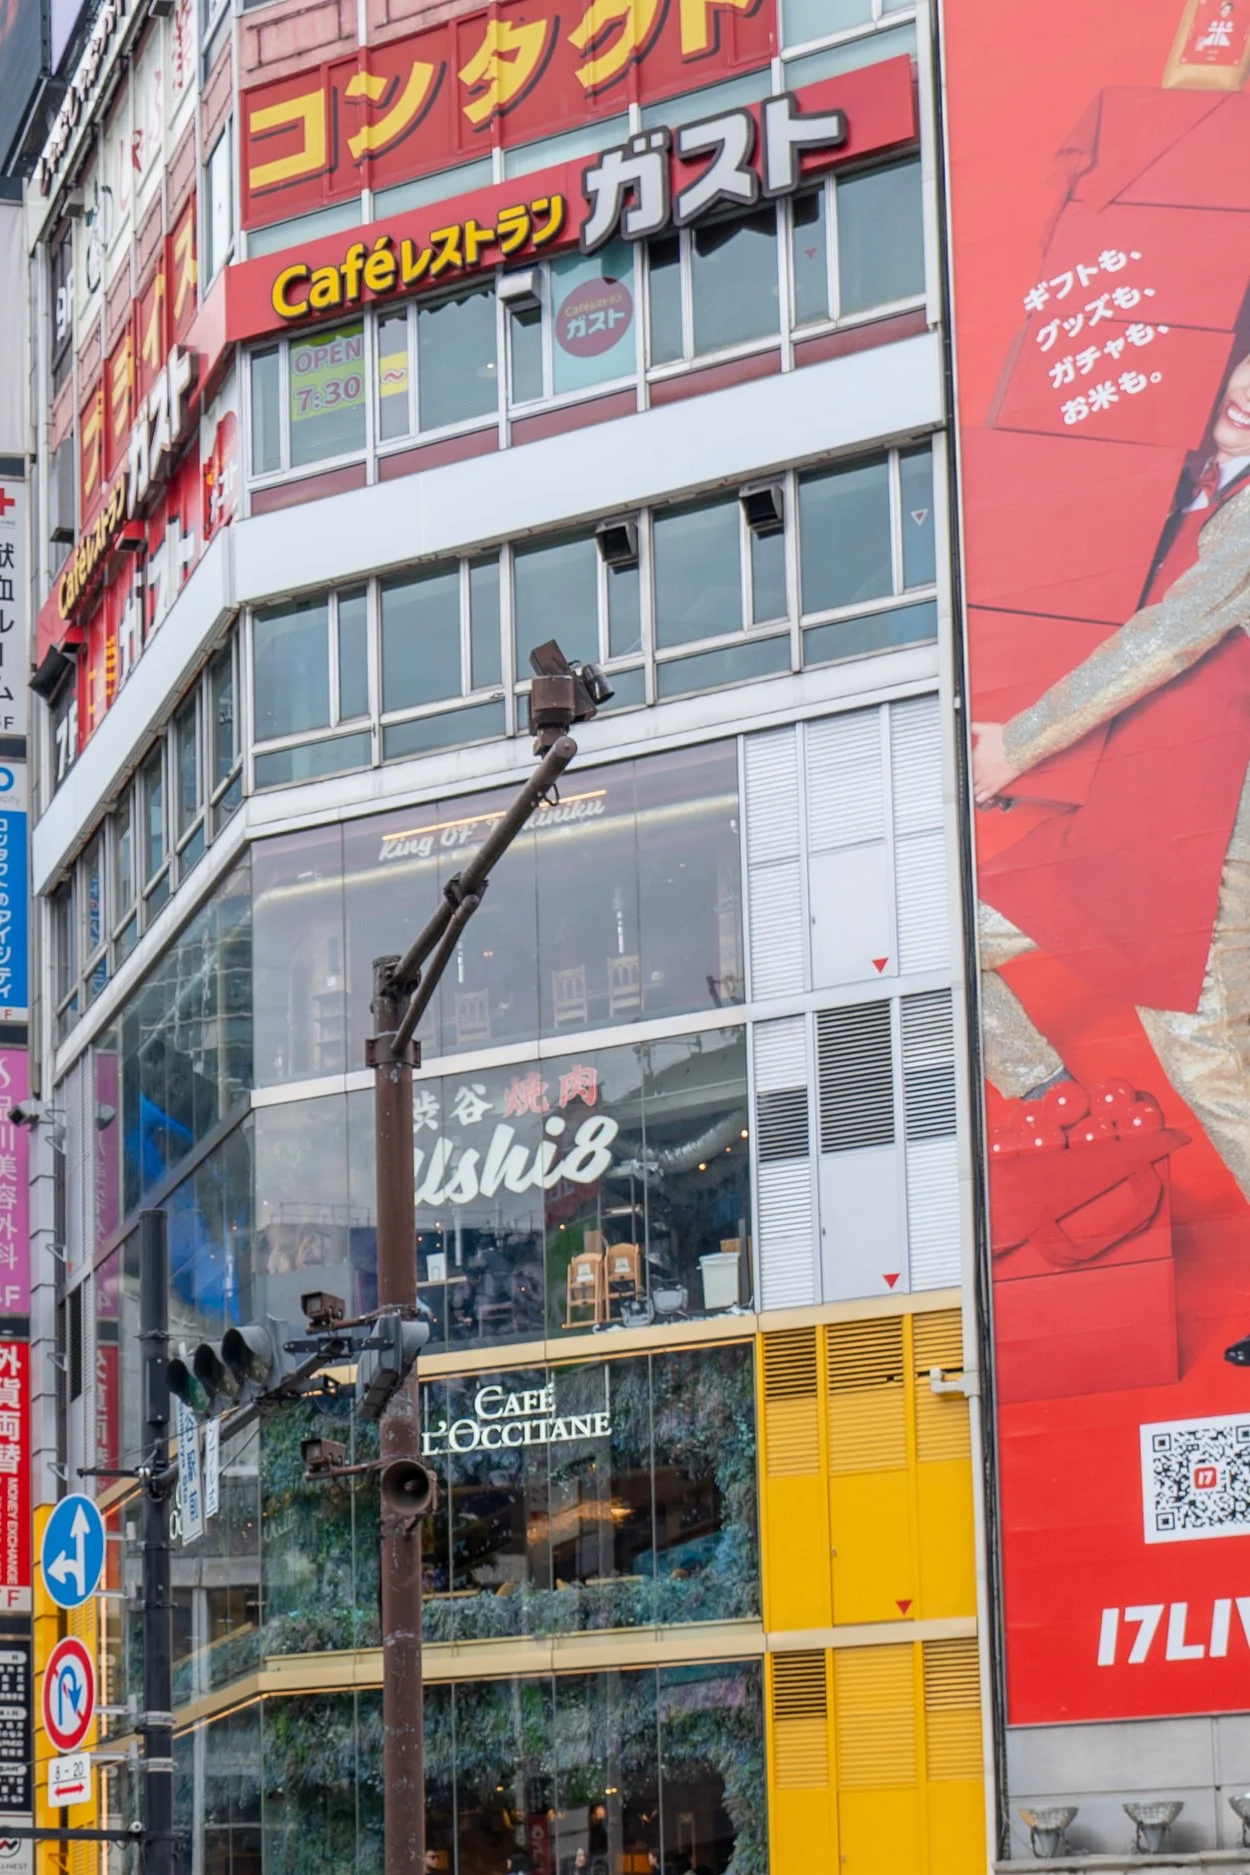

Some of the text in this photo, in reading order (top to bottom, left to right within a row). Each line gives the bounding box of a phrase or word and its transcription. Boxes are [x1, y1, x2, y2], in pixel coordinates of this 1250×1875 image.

[249, 0, 766, 190] コンタクト
[272, 195, 564, 318] Caféレストラン
[581, 92, 845, 254] ガスト
[1023, 247, 1143, 314] ギフトも、
[565, 309, 626, 340] ガスト
[1035, 285, 1156, 352] グッズも、
[294, 338, 362, 376] OPEN
[1048, 322, 1170, 389] ガチャも、
[295, 374, 362, 414] 7:30
[1060, 370, 1163, 425] お米も。
[379, 835, 434, 861] King
[421, 1411, 613, 1457] L'OCCITANE
